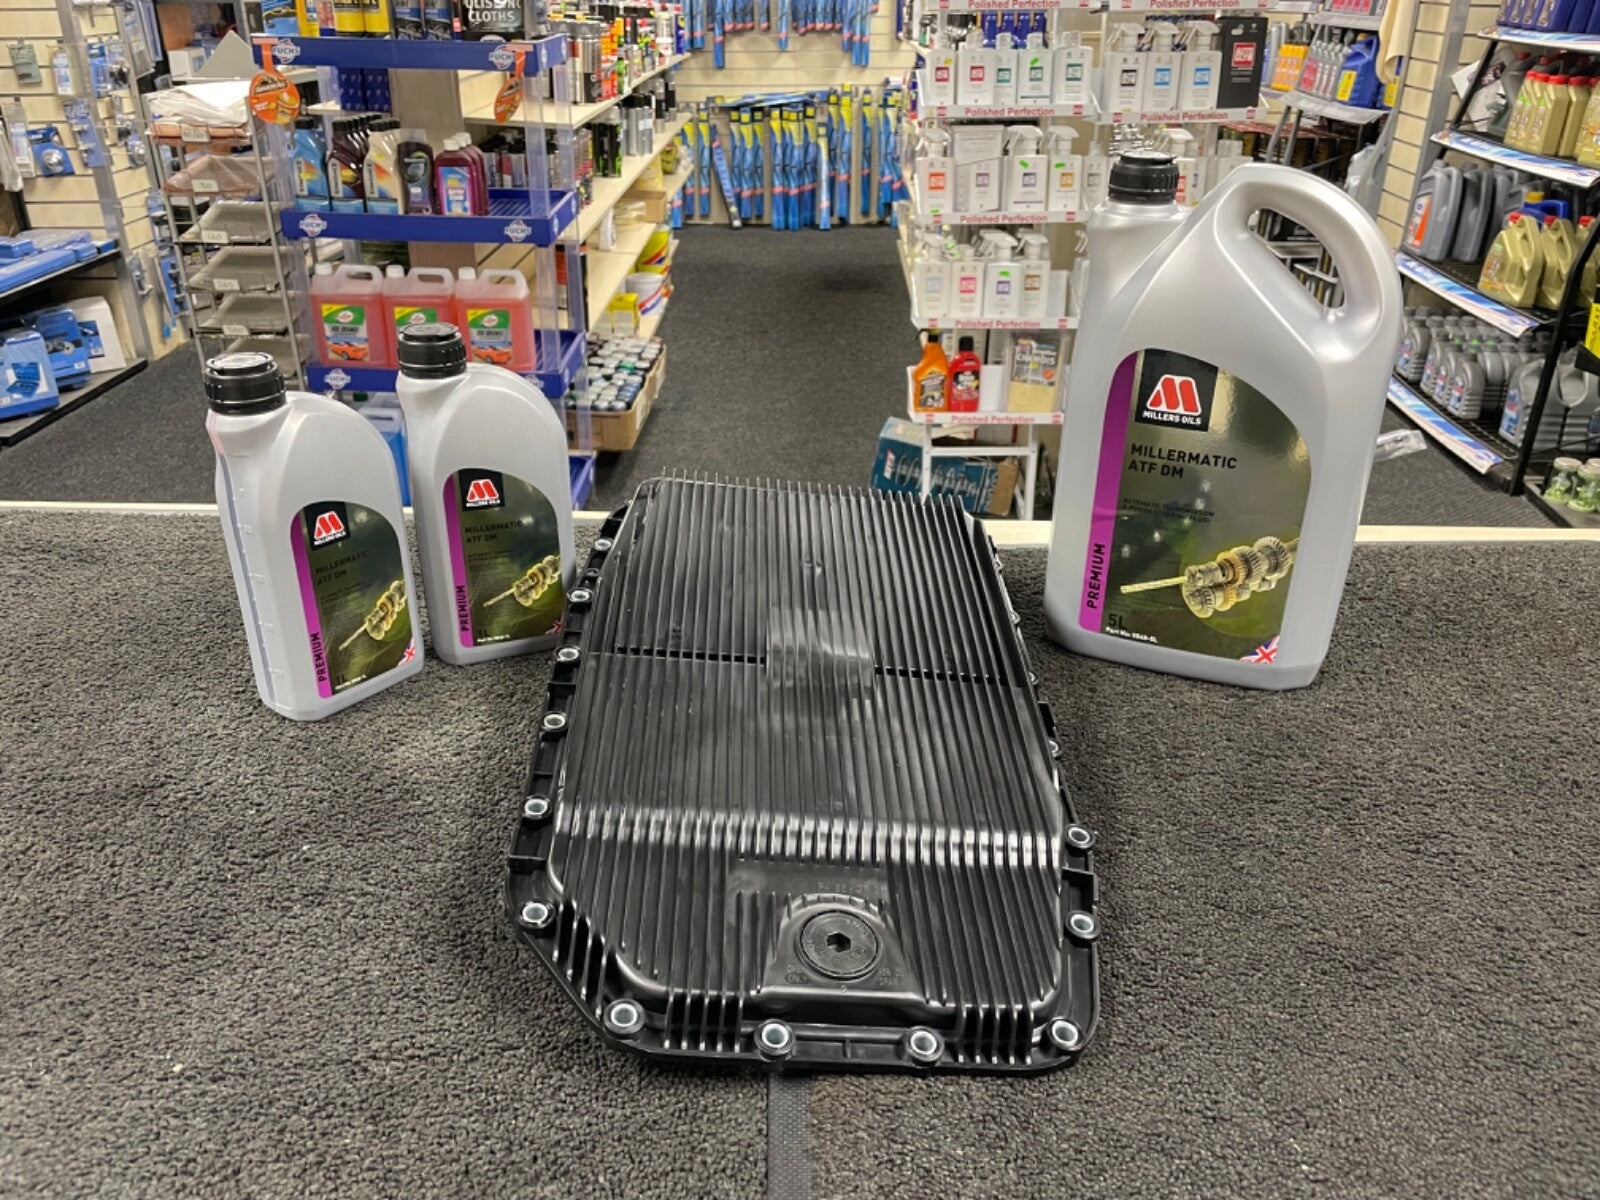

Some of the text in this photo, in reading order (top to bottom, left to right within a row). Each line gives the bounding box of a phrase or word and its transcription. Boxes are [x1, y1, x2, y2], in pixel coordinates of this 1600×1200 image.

[968, 0, 1060, 8] Polished Perfection
[468, 10, 515, 22] CLOTHS
[965, 107, 1055, 116] Polished Perfection
[1140, 112, 1228, 121] Polished Perfection
[960, 214, 1048, 223] Polished Perfection
[955, 320, 1040, 328] Polished Perfection
[951, 415, 1035, 425] Polished Perfection
[1142, 410, 1202, 425] MILLERS OILS
[1130, 443, 1238, 469] MILLERMATIC
[1128, 460, 1185, 479] ATF DM
[465, 520, 523, 533] MILLERMATIC
[1086, 543, 1106, 609] PREMIUM
[455, 585, 470, 632] PREMIUM
[1108, 613, 1128, 630] 5L
[310, 632, 328, 682] PREMIUM
